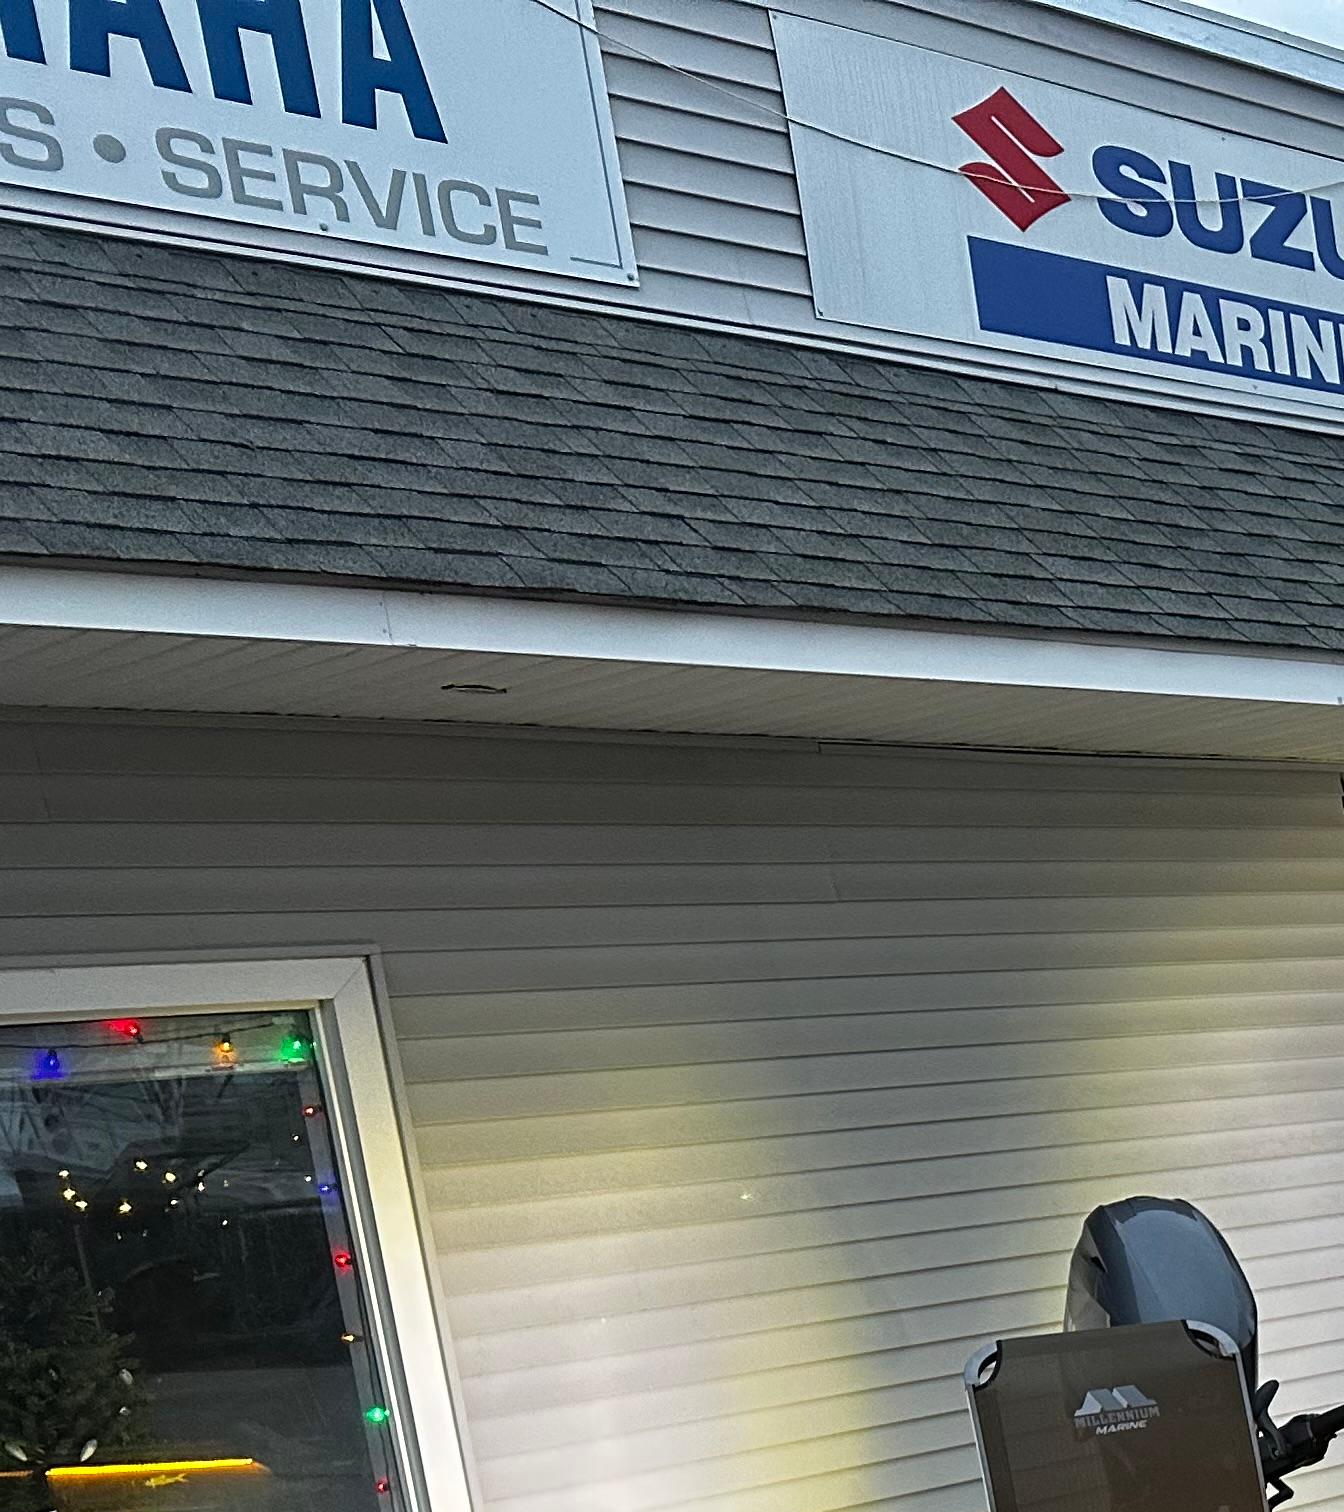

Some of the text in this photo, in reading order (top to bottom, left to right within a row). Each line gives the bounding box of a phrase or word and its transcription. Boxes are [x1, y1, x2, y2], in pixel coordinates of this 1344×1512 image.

[155, 126, 550, 257] SERVICE
[1074, 1405, 1161, 1429] MILLENNIUM
[1095, 1419, 1148, 1436] MARINE
